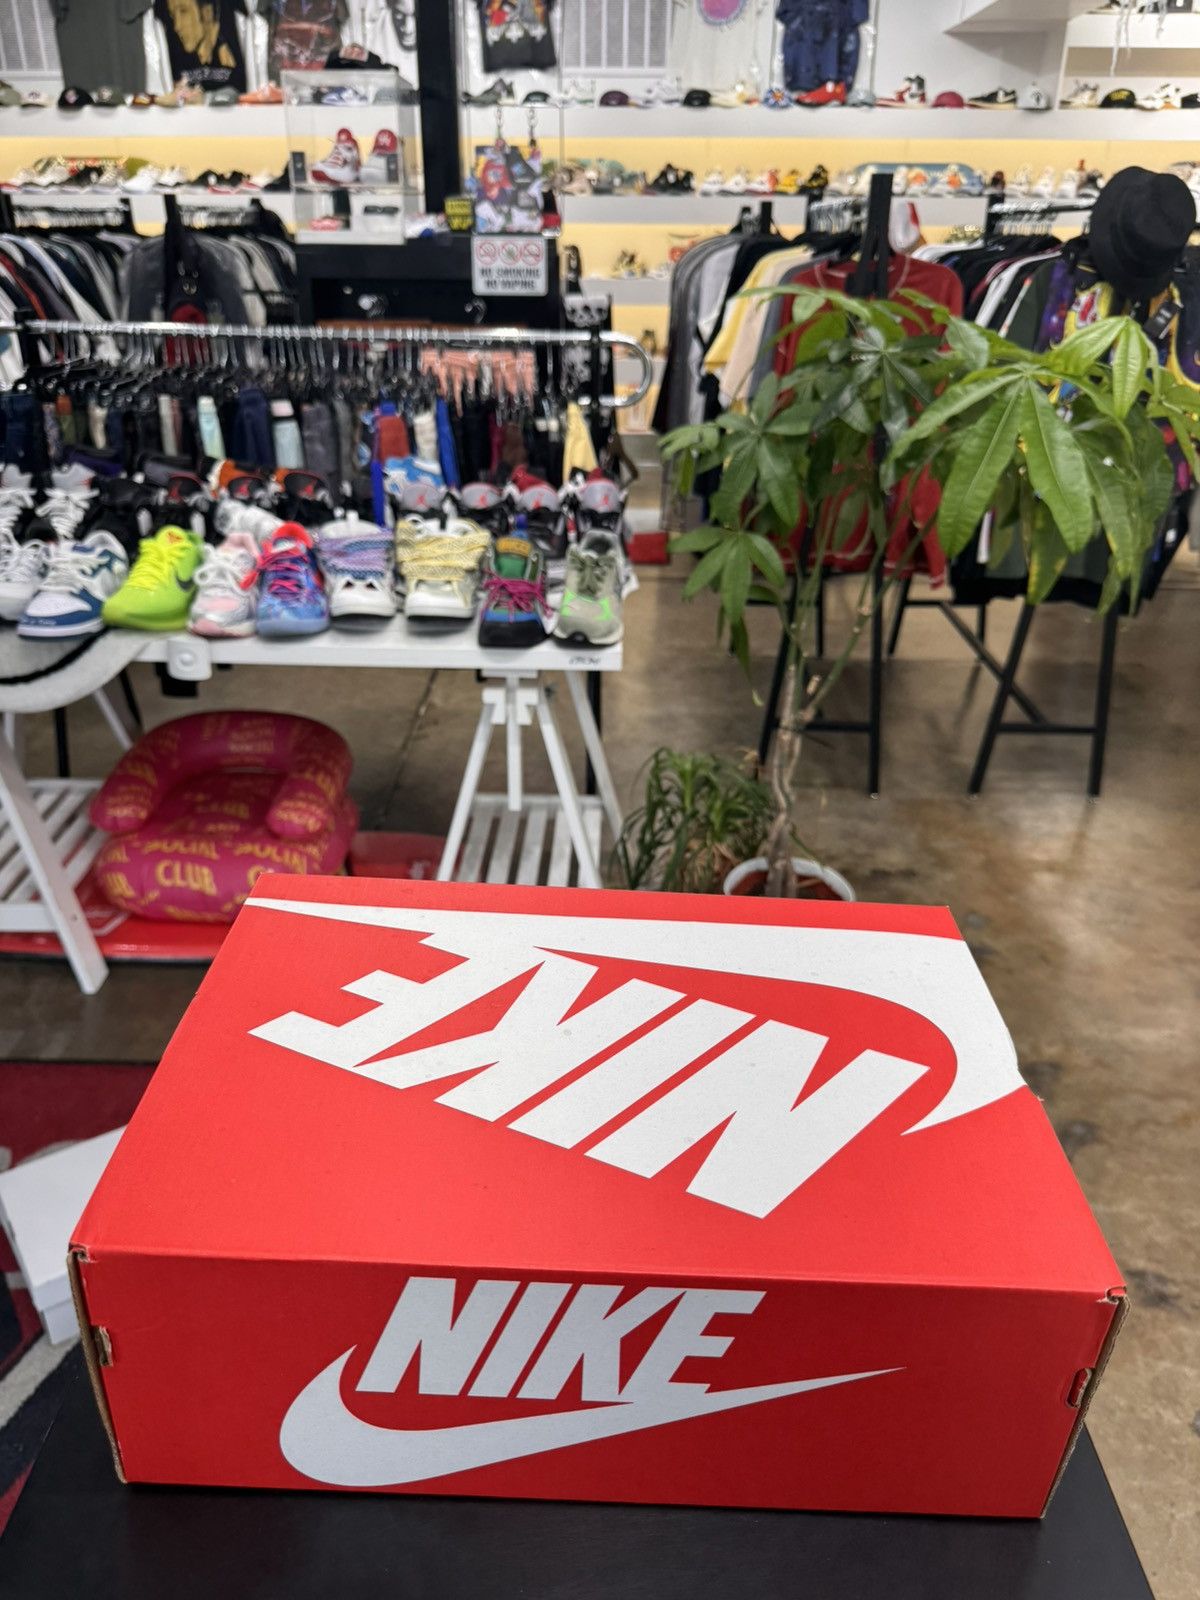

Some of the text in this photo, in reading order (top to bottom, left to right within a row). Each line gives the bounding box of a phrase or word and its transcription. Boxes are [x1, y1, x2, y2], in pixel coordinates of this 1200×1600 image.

[155, 859, 217, 896] CLUB
[247, 931, 930, 1219] NIKE
[355, 1275, 767, 1404] NIKE
